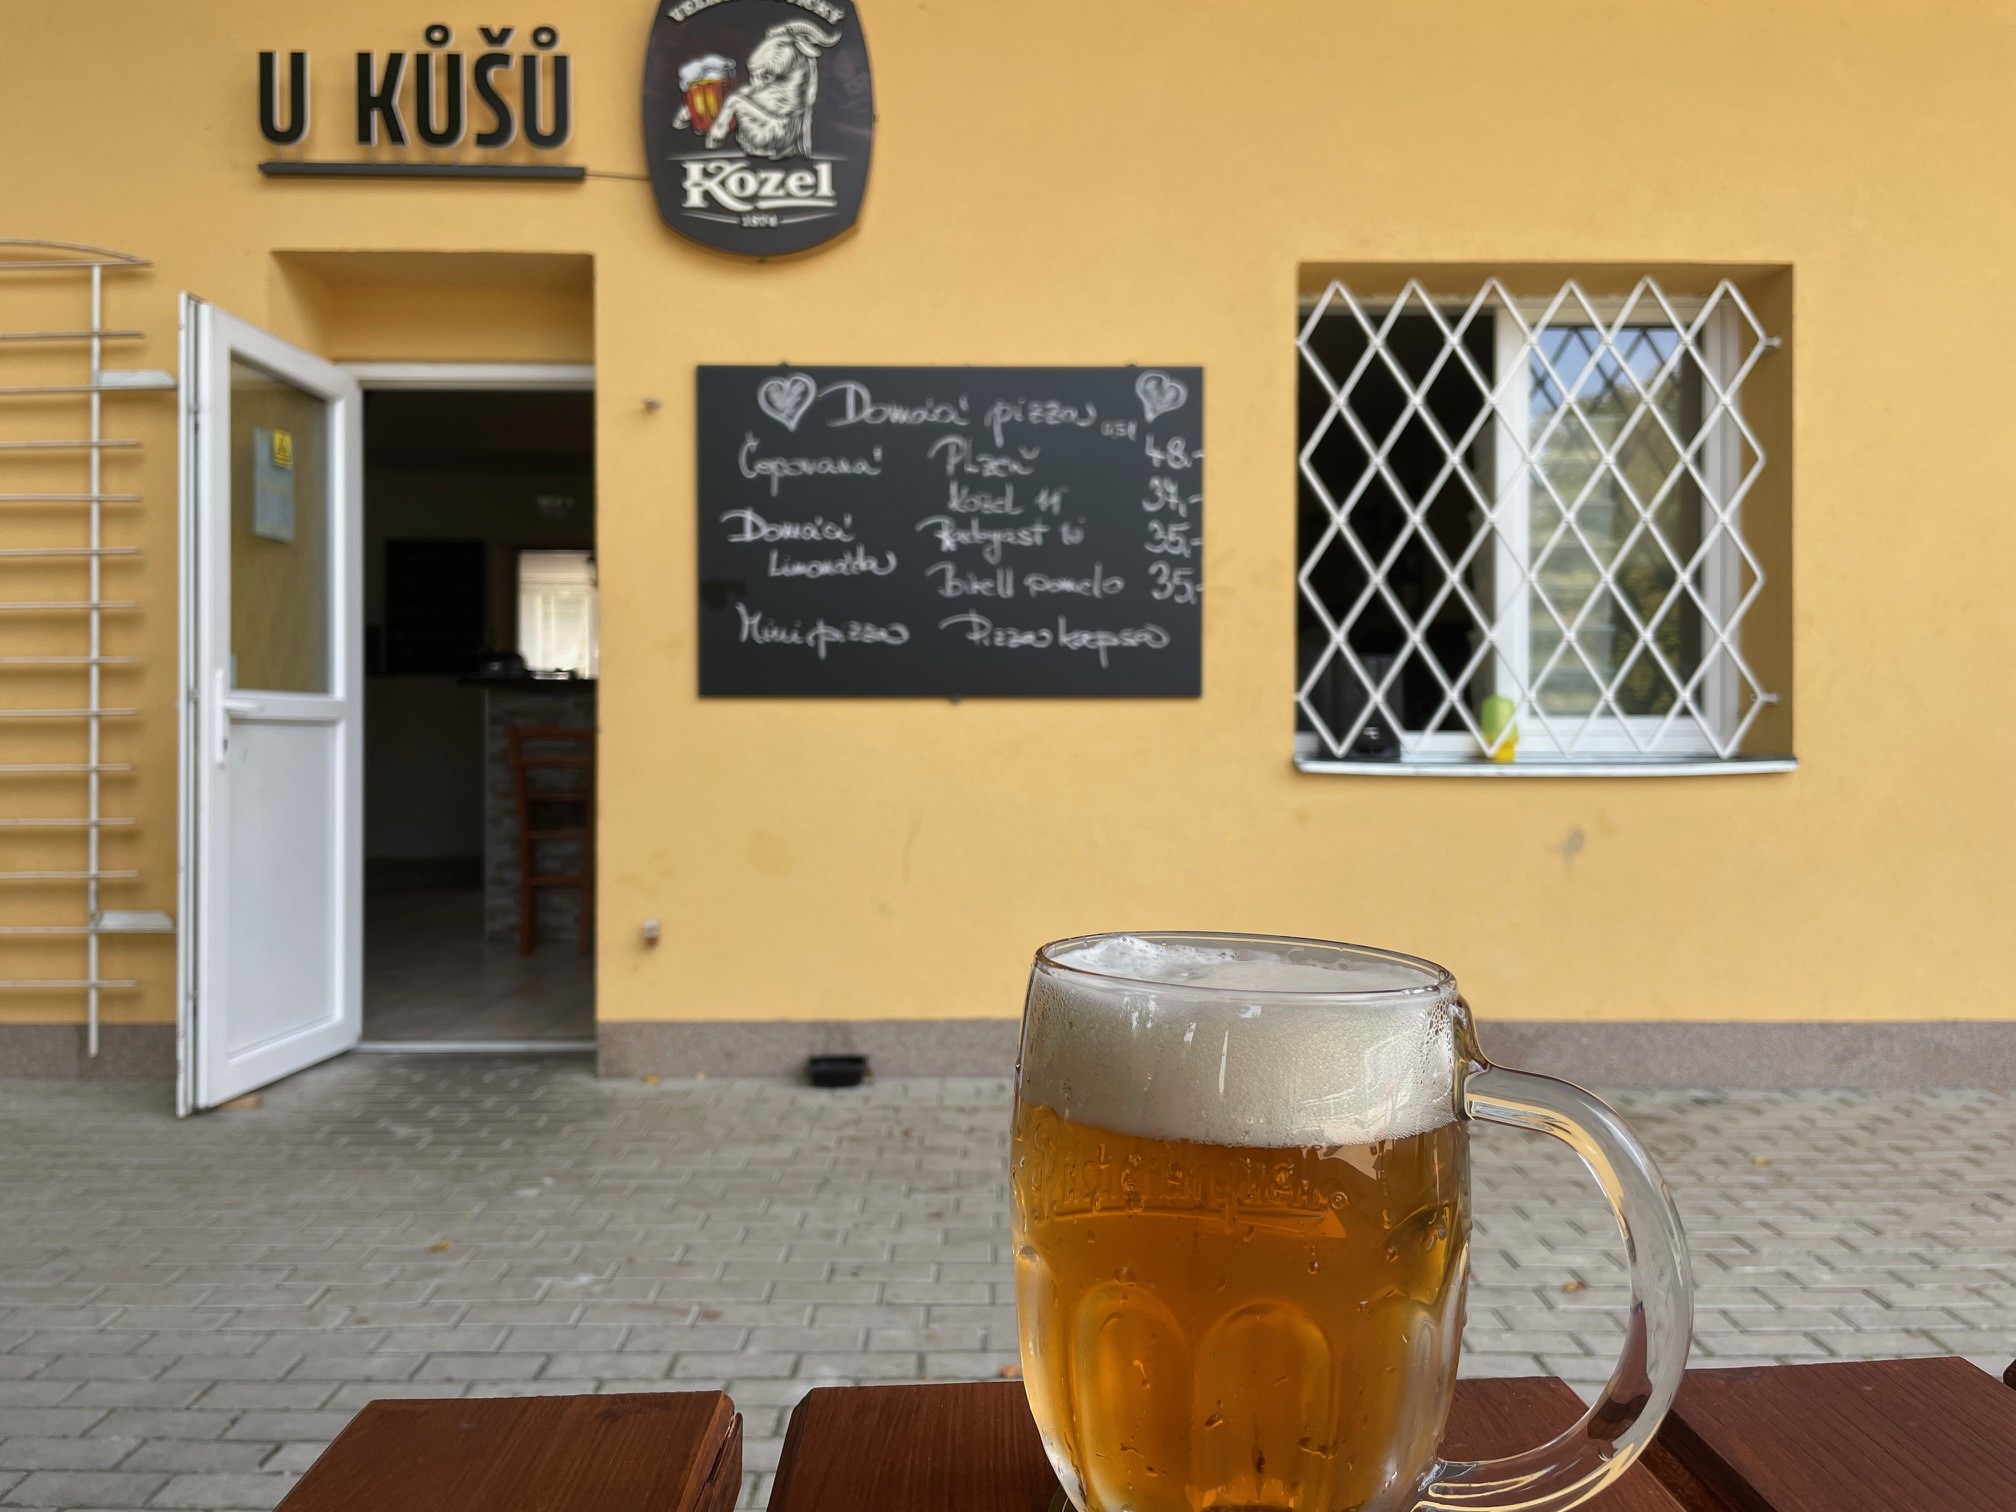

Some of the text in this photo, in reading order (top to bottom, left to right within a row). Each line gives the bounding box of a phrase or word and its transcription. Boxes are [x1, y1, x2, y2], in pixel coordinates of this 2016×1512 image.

[258, 25, 571, 148] U KŮŠŮ
[681, 160, 838, 212] Kozel
